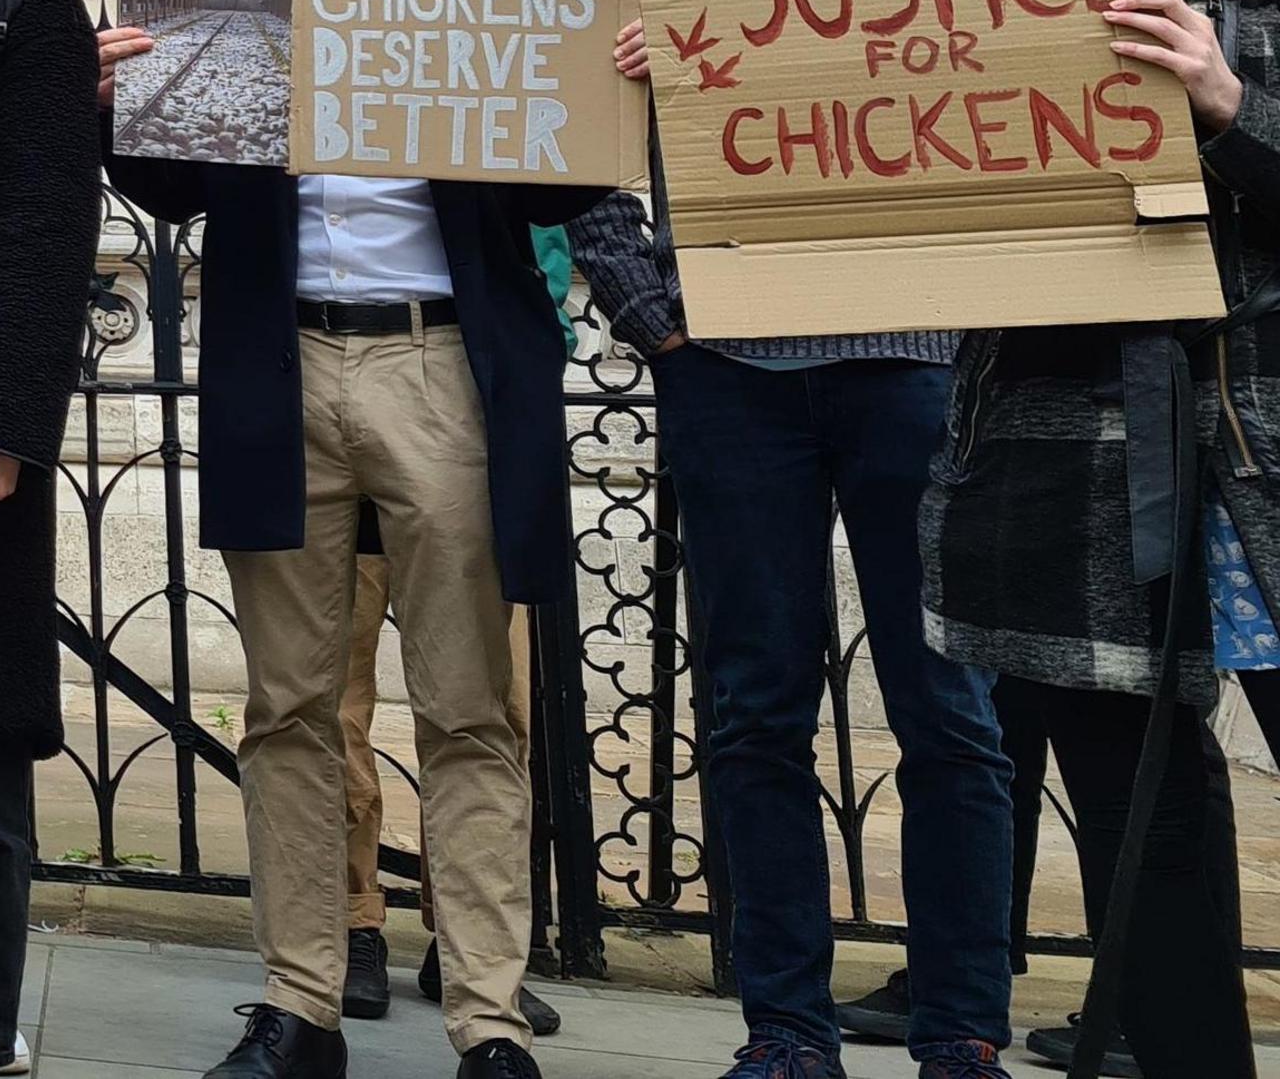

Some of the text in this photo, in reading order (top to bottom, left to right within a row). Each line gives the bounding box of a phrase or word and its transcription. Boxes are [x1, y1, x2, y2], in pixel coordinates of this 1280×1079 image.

[313, 27, 562, 91] DESERVE
[865, 30, 985, 78] FOR
[313, 92, 569, 174] BETTER
[722, 72, 1164, 179] CHICKENS
